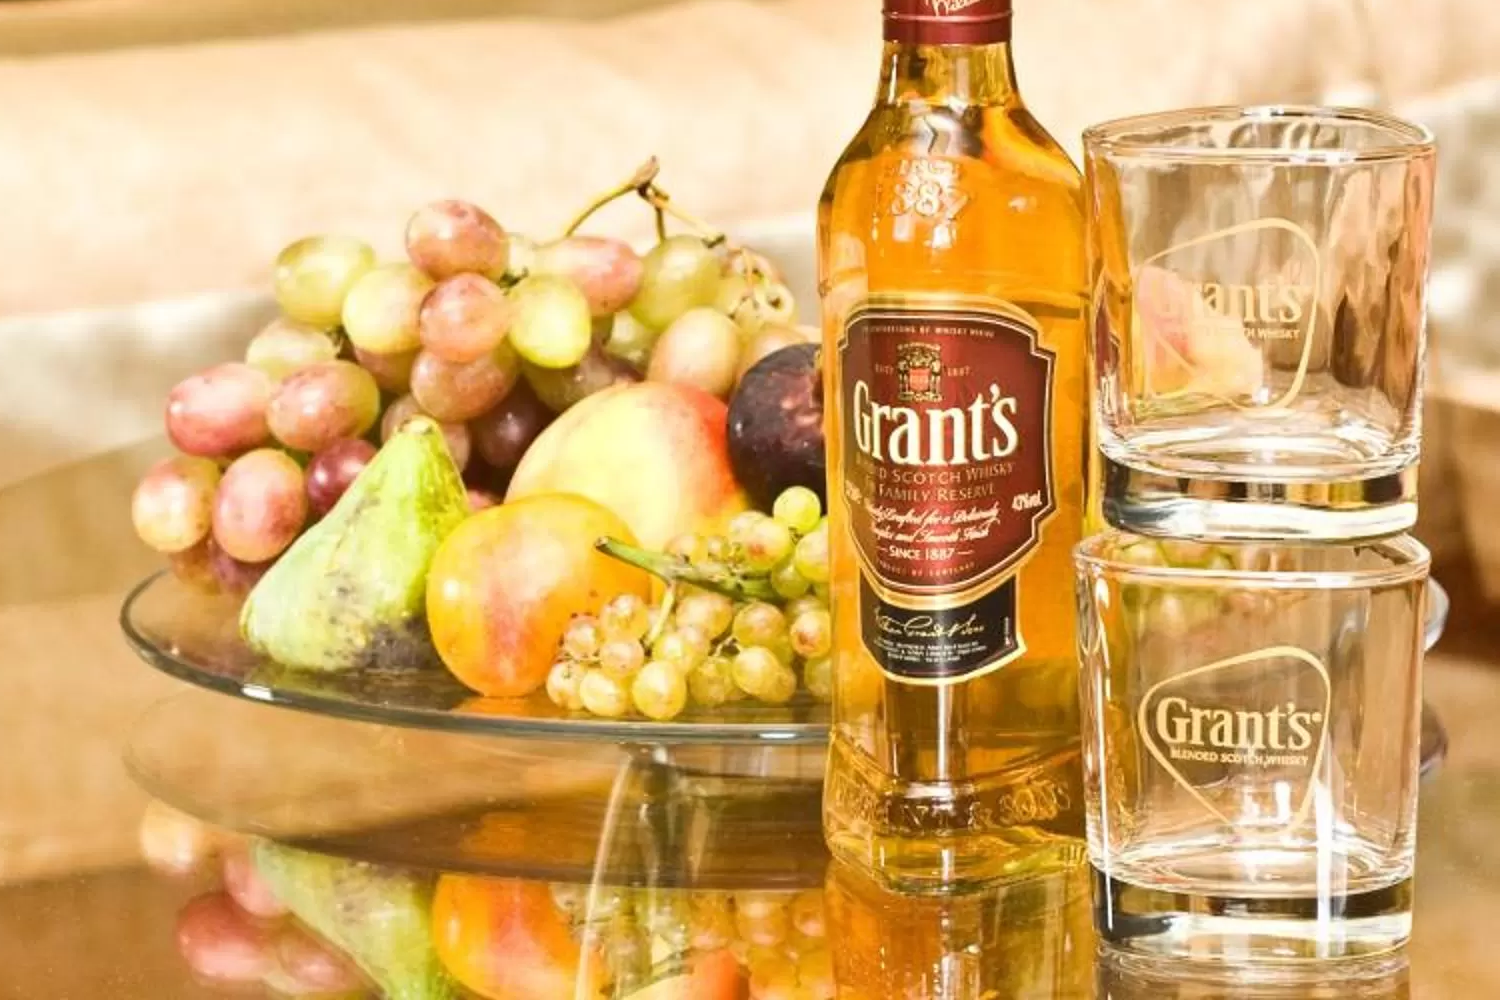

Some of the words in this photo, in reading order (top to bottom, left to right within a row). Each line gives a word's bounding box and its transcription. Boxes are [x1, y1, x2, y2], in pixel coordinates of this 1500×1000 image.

[854, 380, 1018, 466] Grant's
[892, 469, 961, 485] SCOTCH
[966, 463, 1014, 481] WHISKY
[879, 483, 931, 502] FAMILY
[937, 484, 996, 502] RESERVE
[889, 545, 921, 559] SINCE
[925, 547, 955, 561] 1887
[1156, 696, 1313, 751] Grant's
[1170, 747, 1218, 763] BLENDED
[1219, 751, 1264, 766] SCOTCH
[1264, 753, 1309, 768] WHISKY
